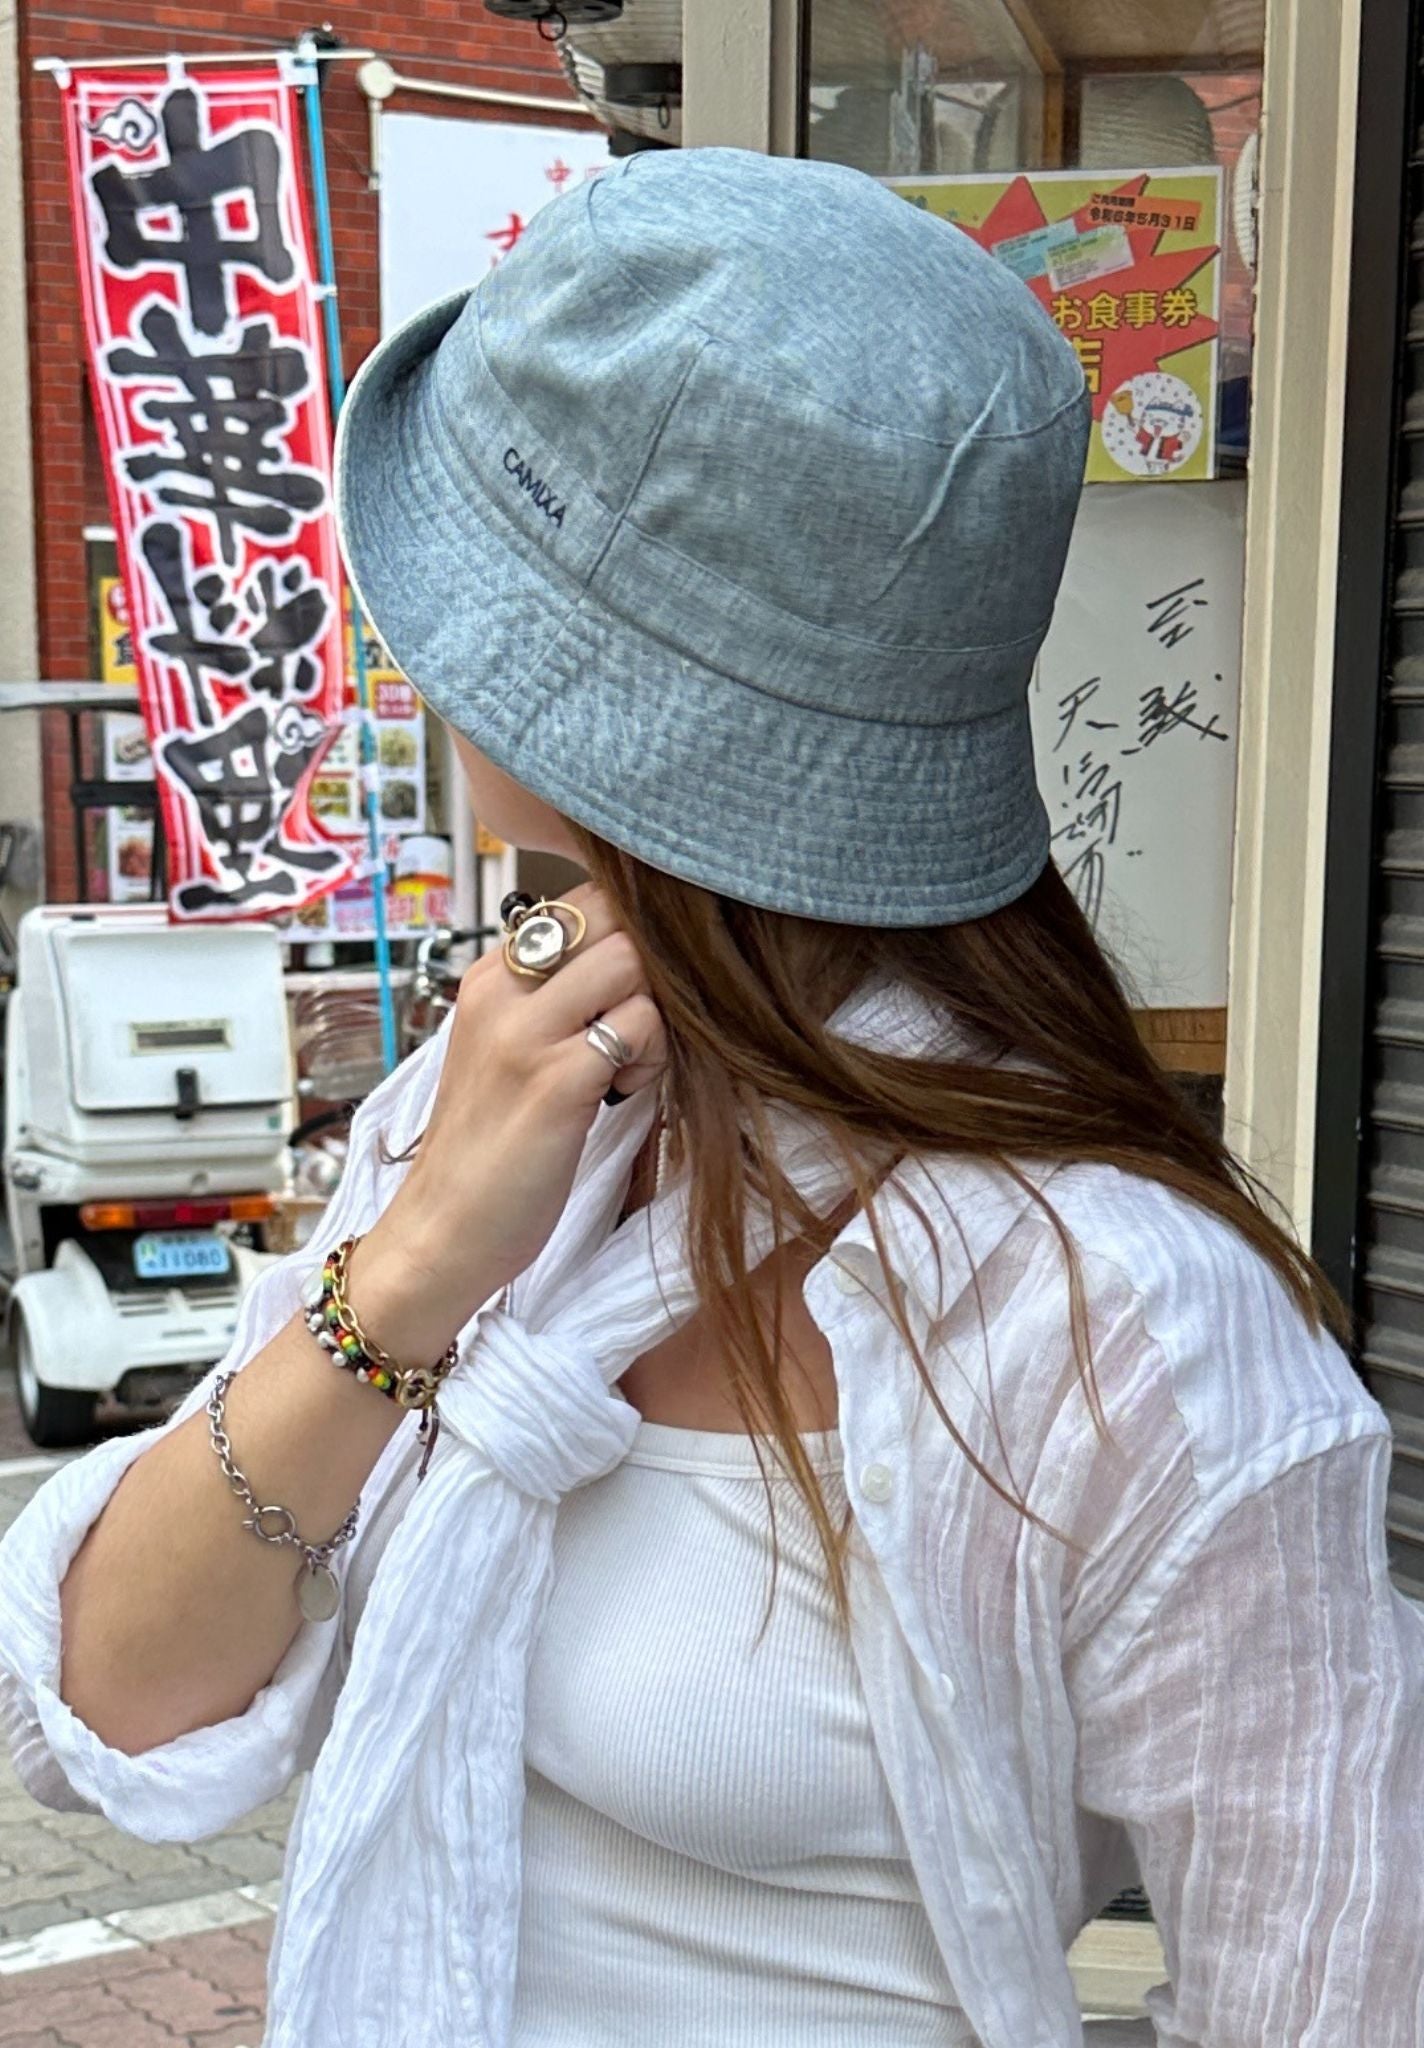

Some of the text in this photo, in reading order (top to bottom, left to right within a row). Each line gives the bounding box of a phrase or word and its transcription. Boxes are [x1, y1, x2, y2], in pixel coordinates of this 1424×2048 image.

[1051, 289, 1198, 333] お食事券
[503, 447, 567, 530] CAMIXA
